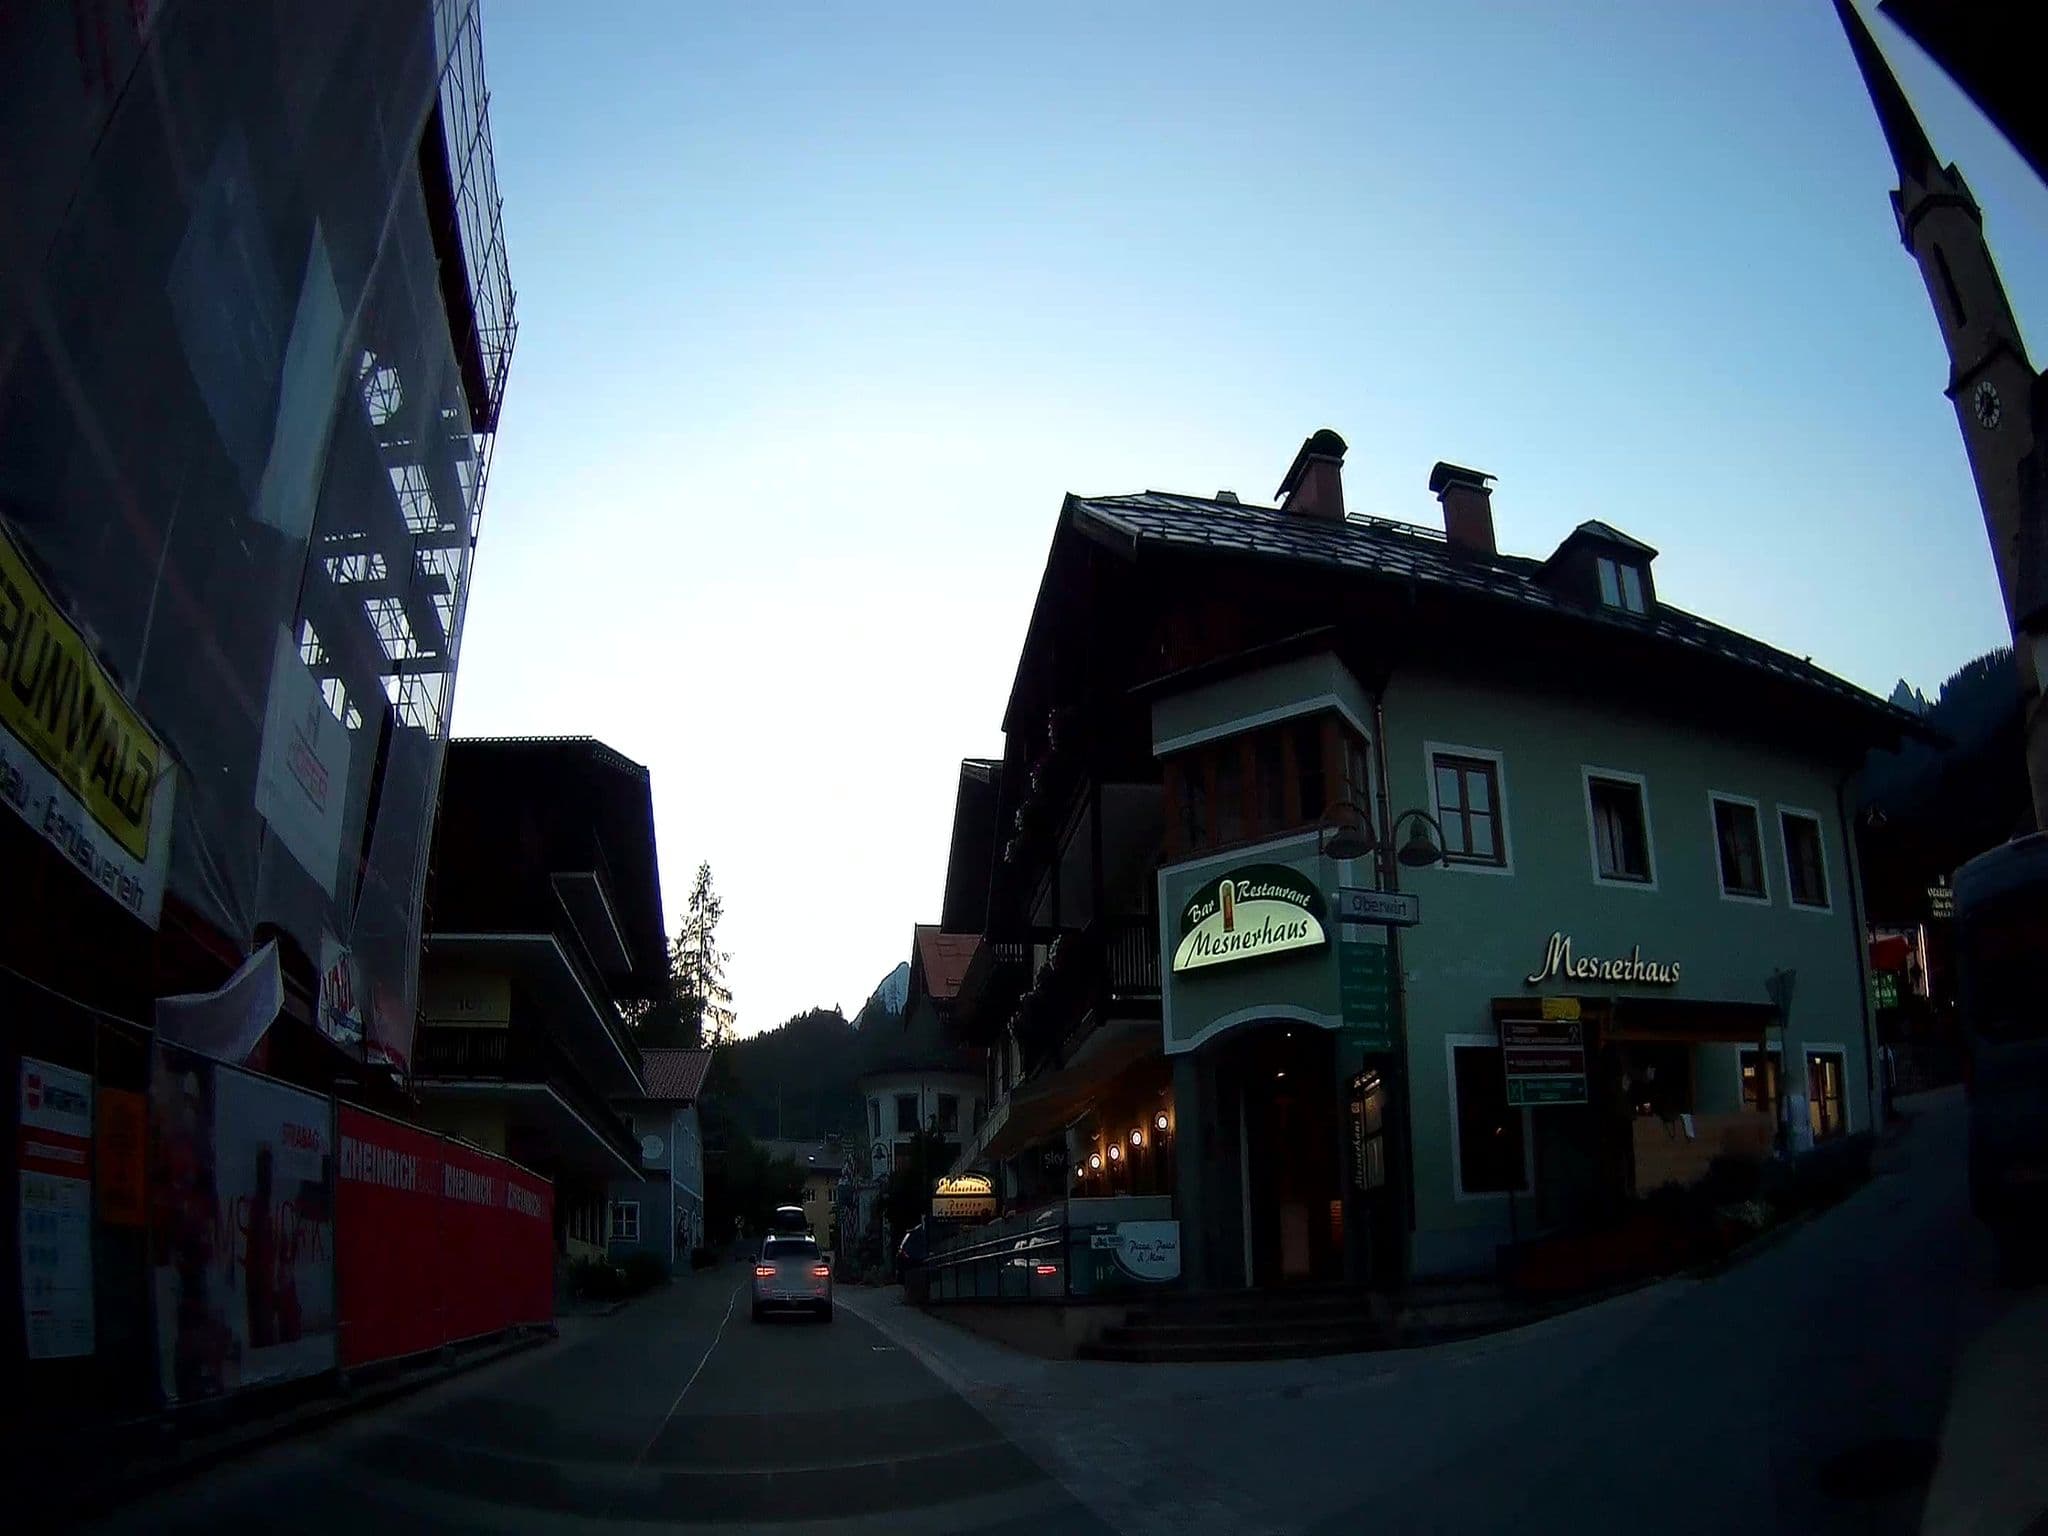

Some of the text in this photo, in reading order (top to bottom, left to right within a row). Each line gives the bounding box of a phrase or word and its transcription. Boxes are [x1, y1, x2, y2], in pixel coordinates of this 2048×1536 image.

[1187, 879, 1312, 923] Bar Restaurant
[1183, 914, 1309, 968] Mesnerhaus
[1527, 930, 1682, 984] Mesnerhaus
